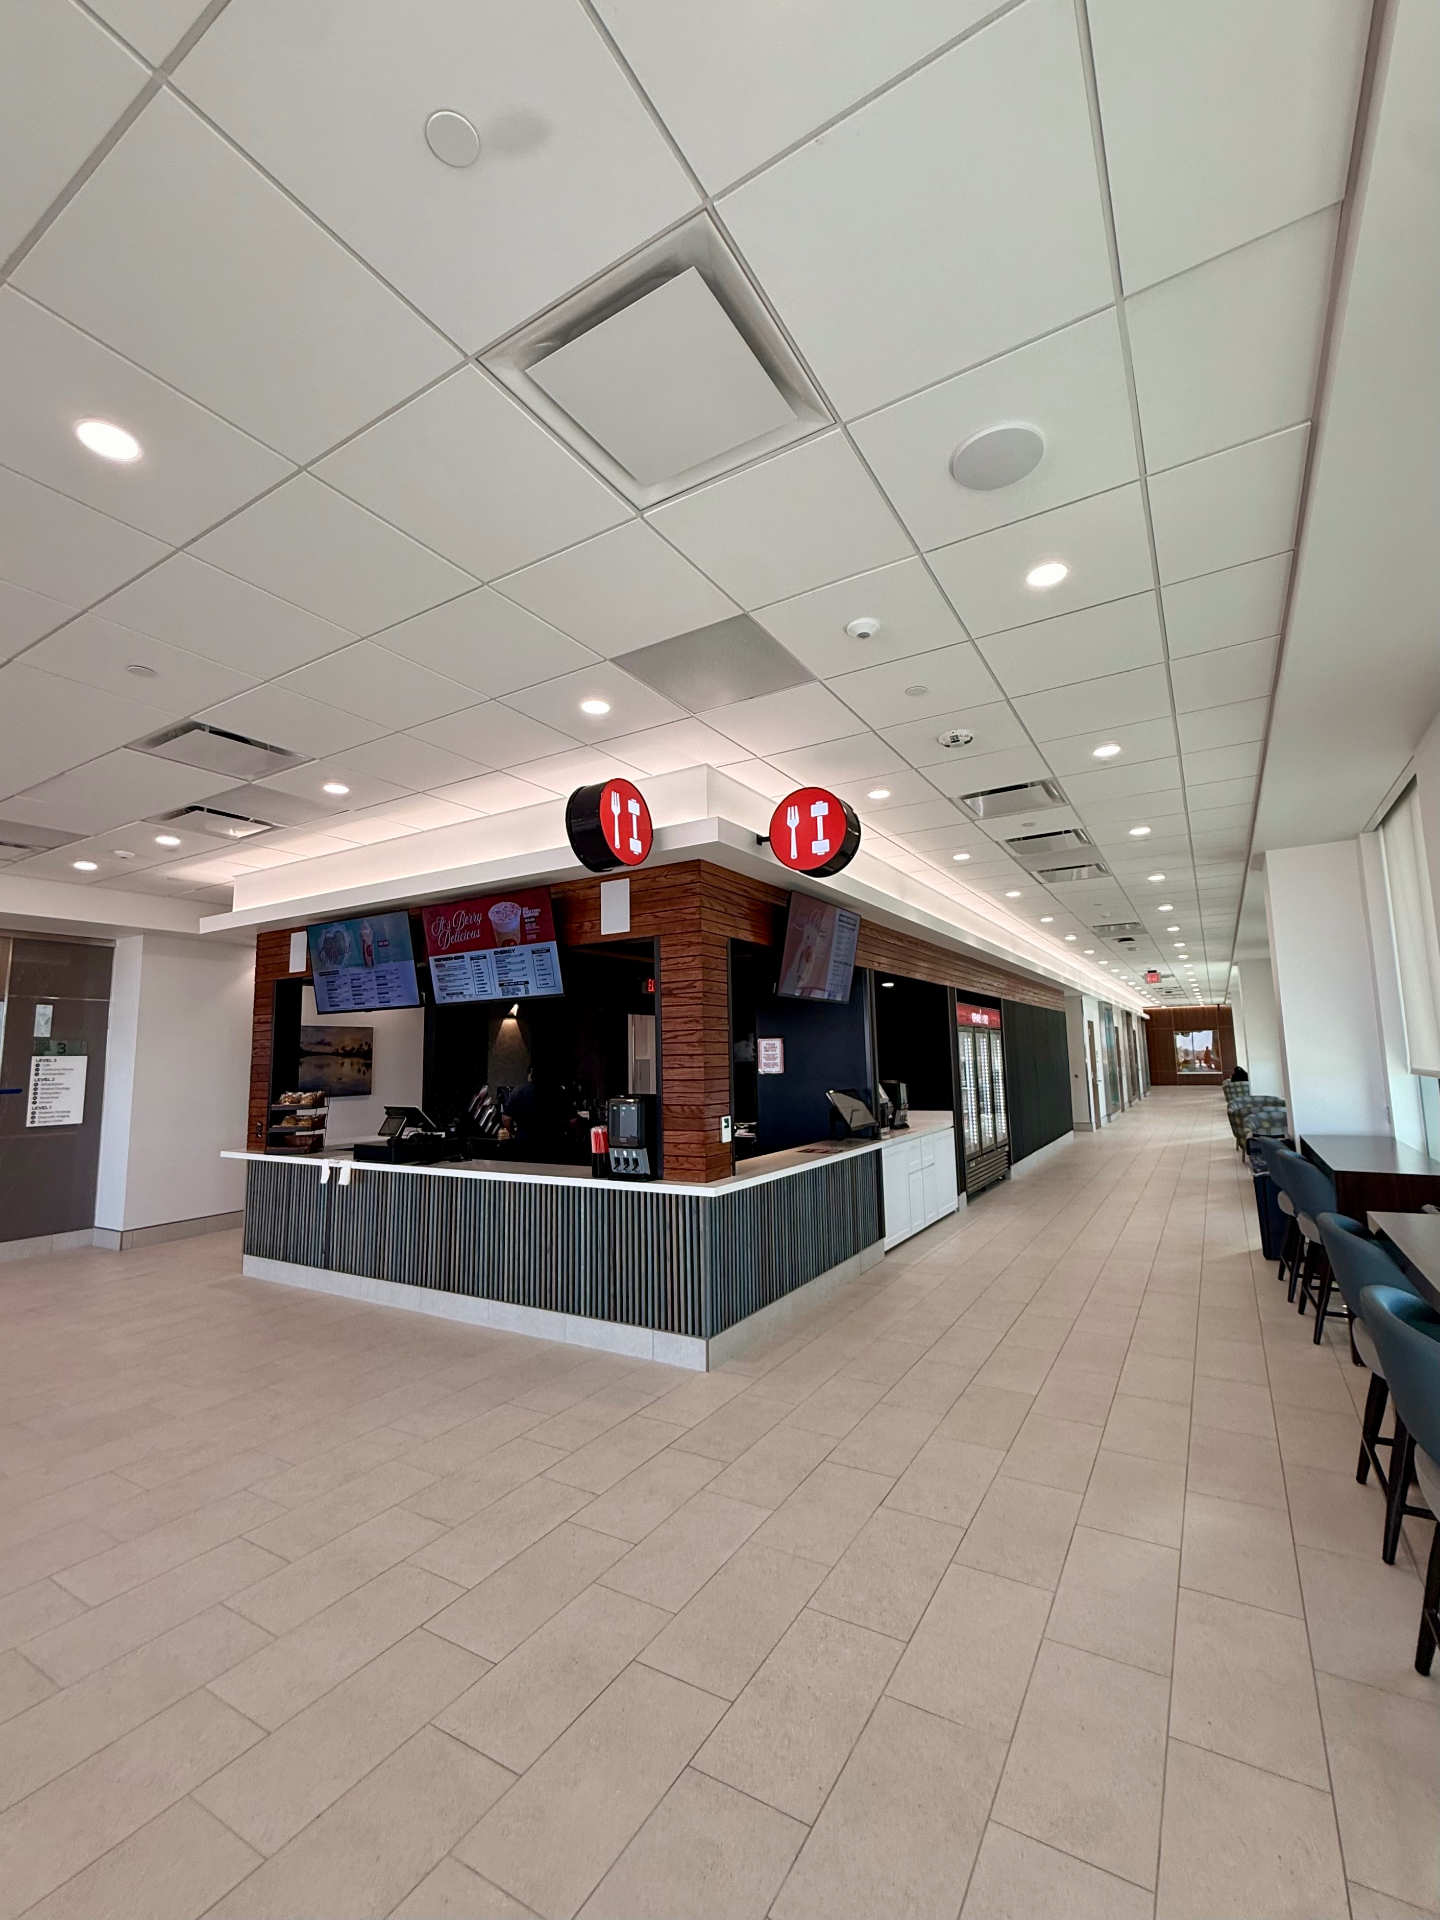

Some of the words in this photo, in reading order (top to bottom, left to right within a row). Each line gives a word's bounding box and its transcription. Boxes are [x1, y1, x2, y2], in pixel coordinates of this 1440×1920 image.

[431, 915, 451, 936] It's
[452, 910, 483, 931] Berry
[438, 928, 482, 950] Delicious
[493, 948, 516, 956] ENERGY
[56, 1042, 67, 1054] 3
